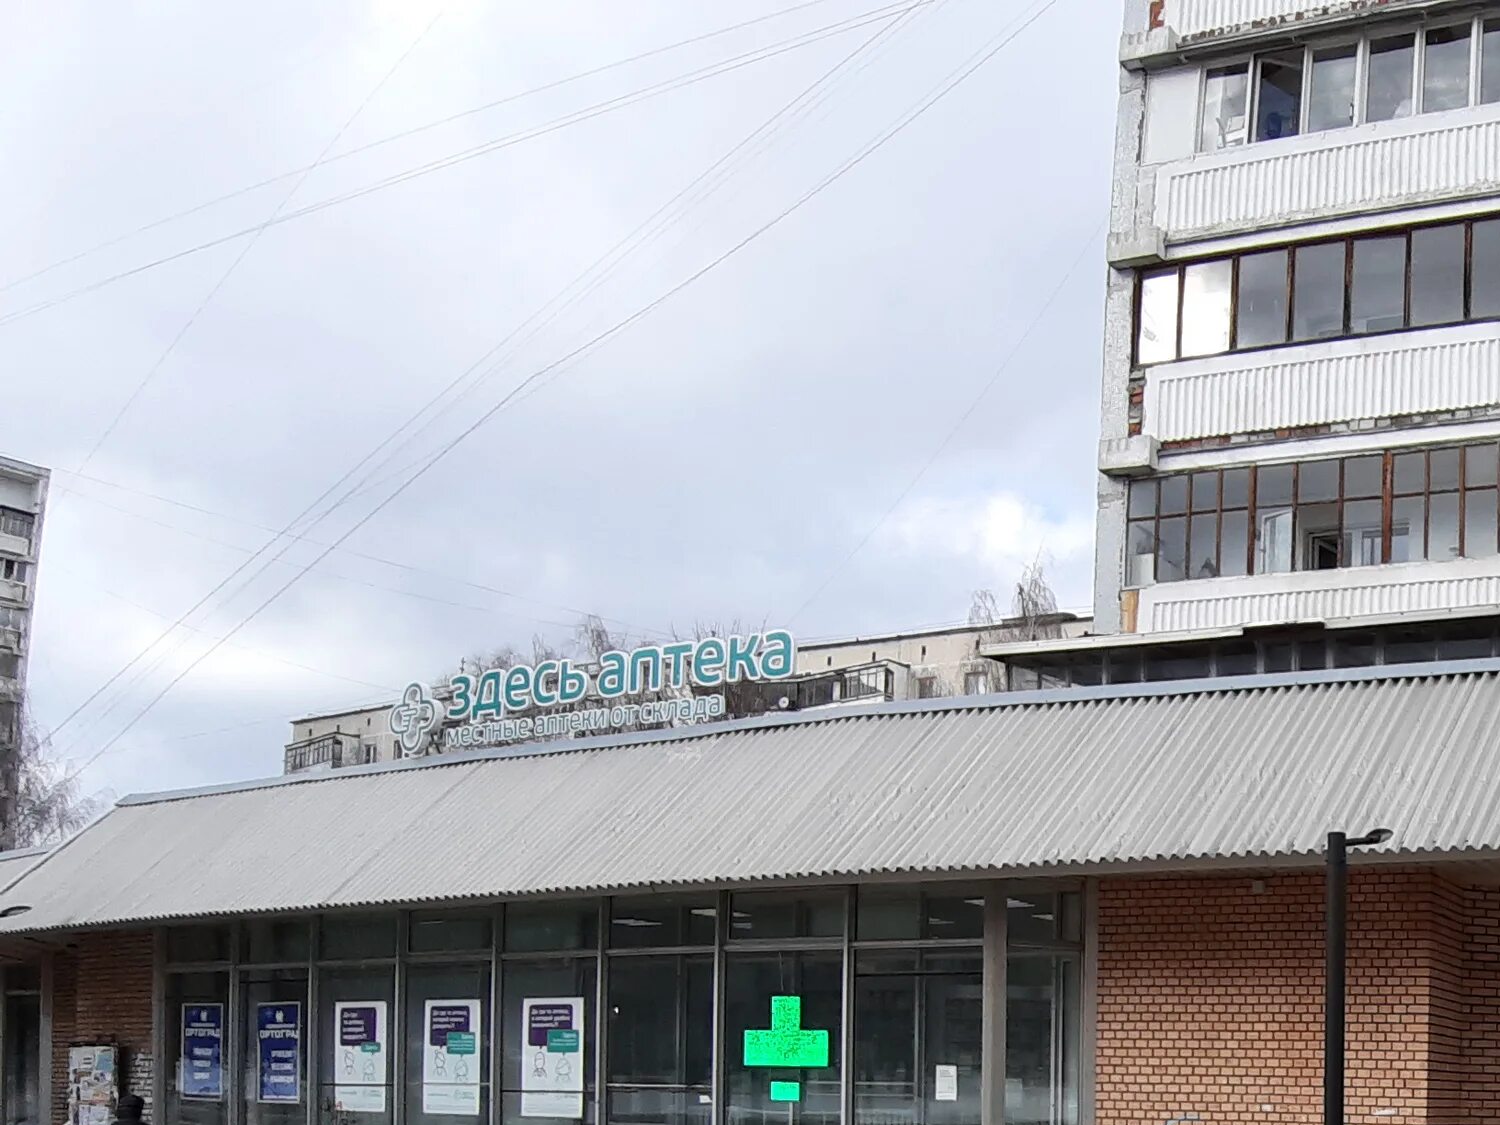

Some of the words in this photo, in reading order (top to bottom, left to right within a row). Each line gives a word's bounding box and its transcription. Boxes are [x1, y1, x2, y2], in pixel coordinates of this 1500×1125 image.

[446, 658, 590, 723] здесь
[597, 629, 796, 698] аптека
[446, 717, 533, 747] местные
[534, 708, 607, 738] аптеки
[610, 704, 637, 728] от
[640, 693, 726, 725] склада
